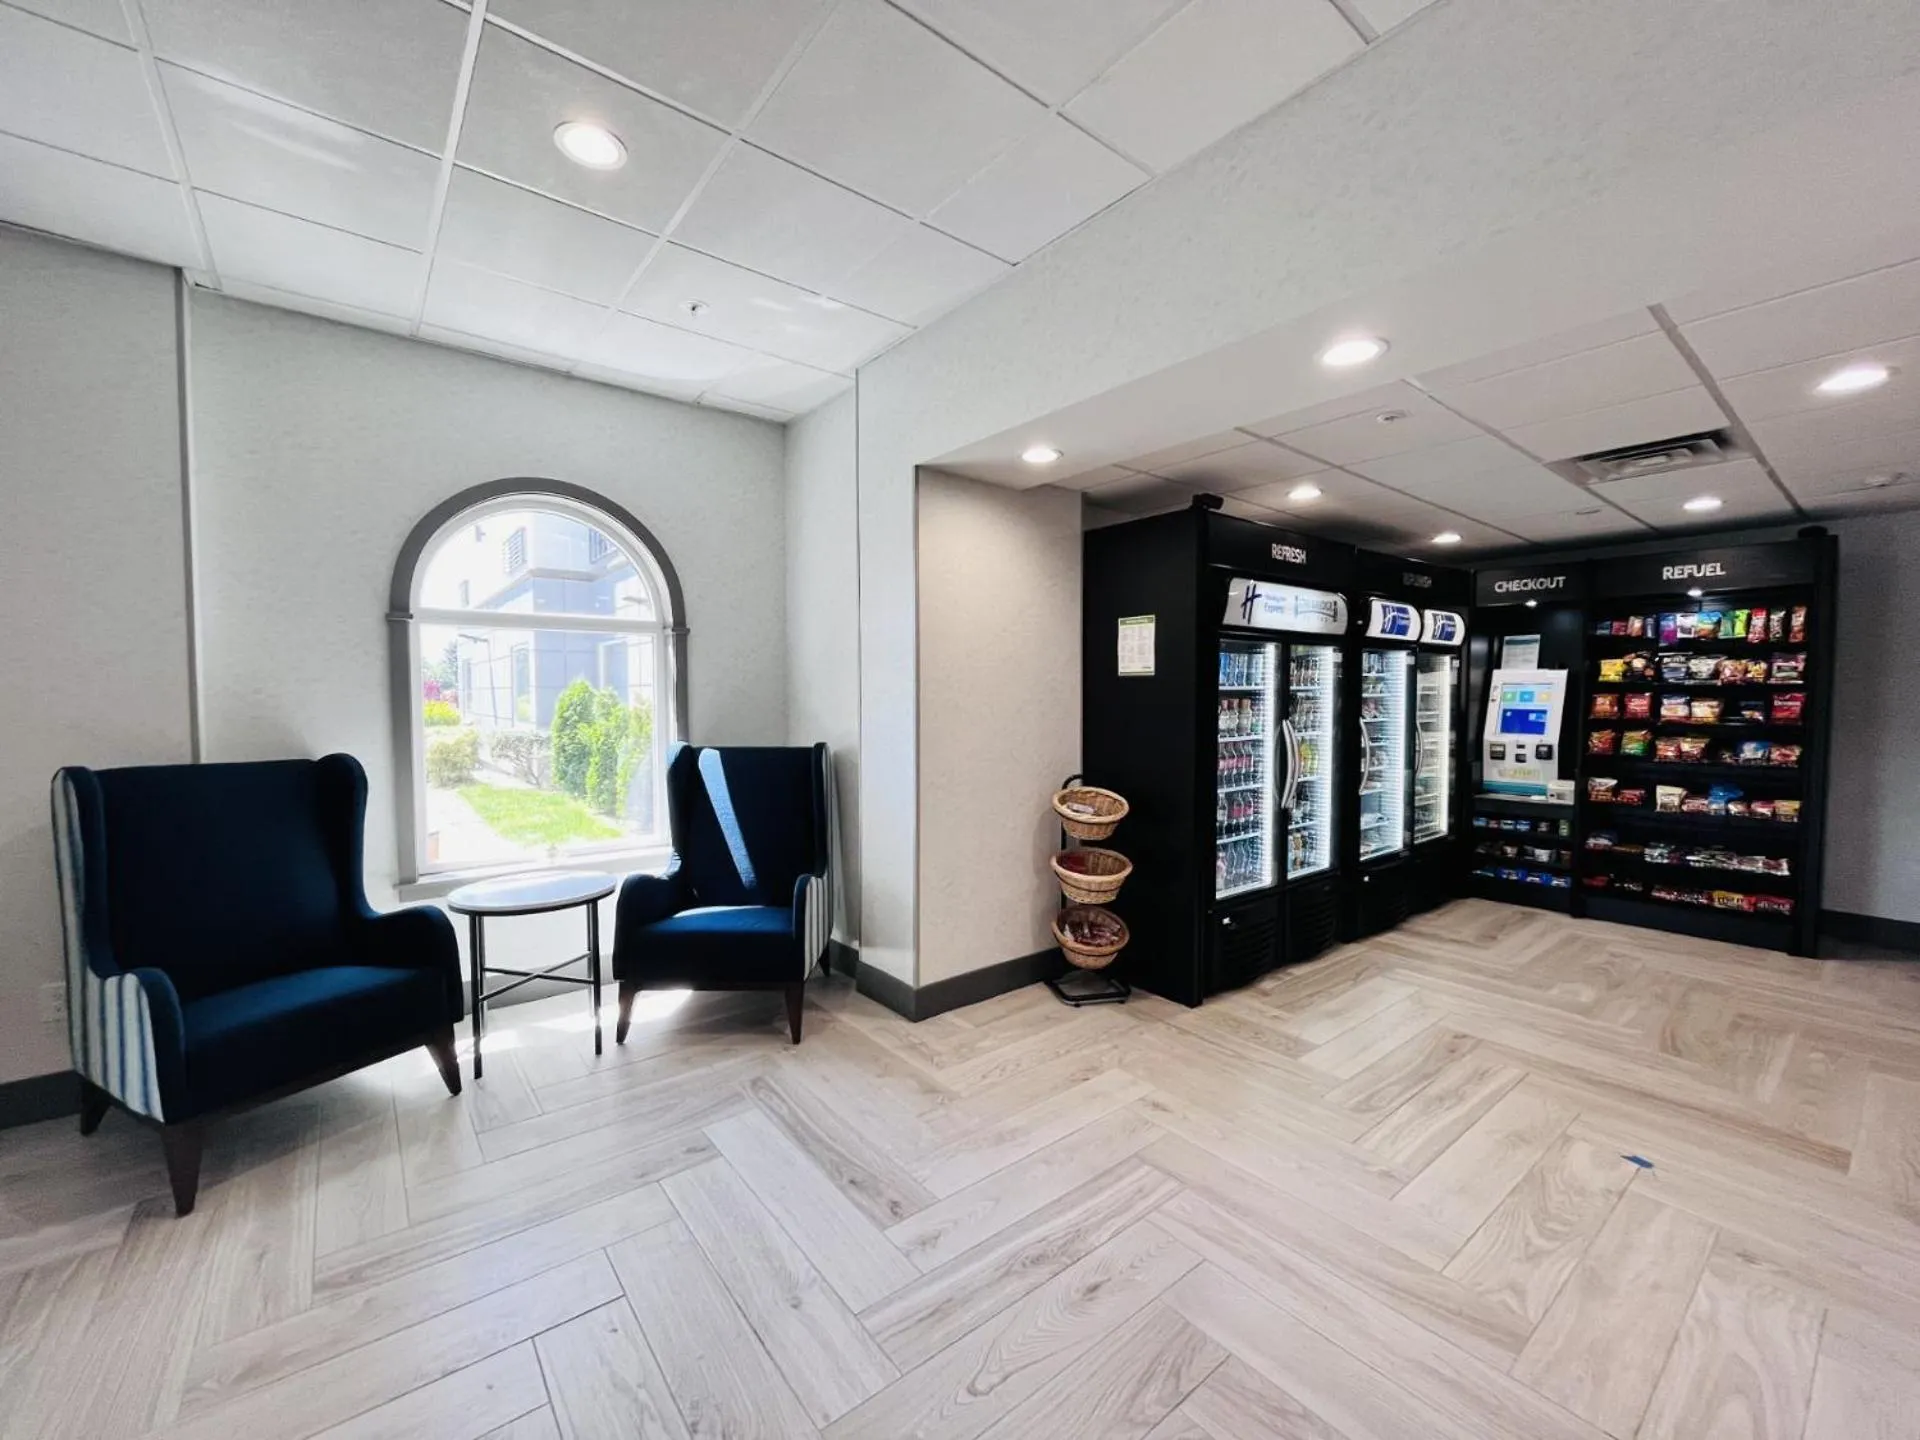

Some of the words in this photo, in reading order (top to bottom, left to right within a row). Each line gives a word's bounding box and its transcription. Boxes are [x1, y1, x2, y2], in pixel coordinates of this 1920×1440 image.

[1271, 543, 1307, 564] REFRESH
[1662, 562, 1727, 580] REFUEL
[1494, 576, 1567, 593] CHECKOUT
